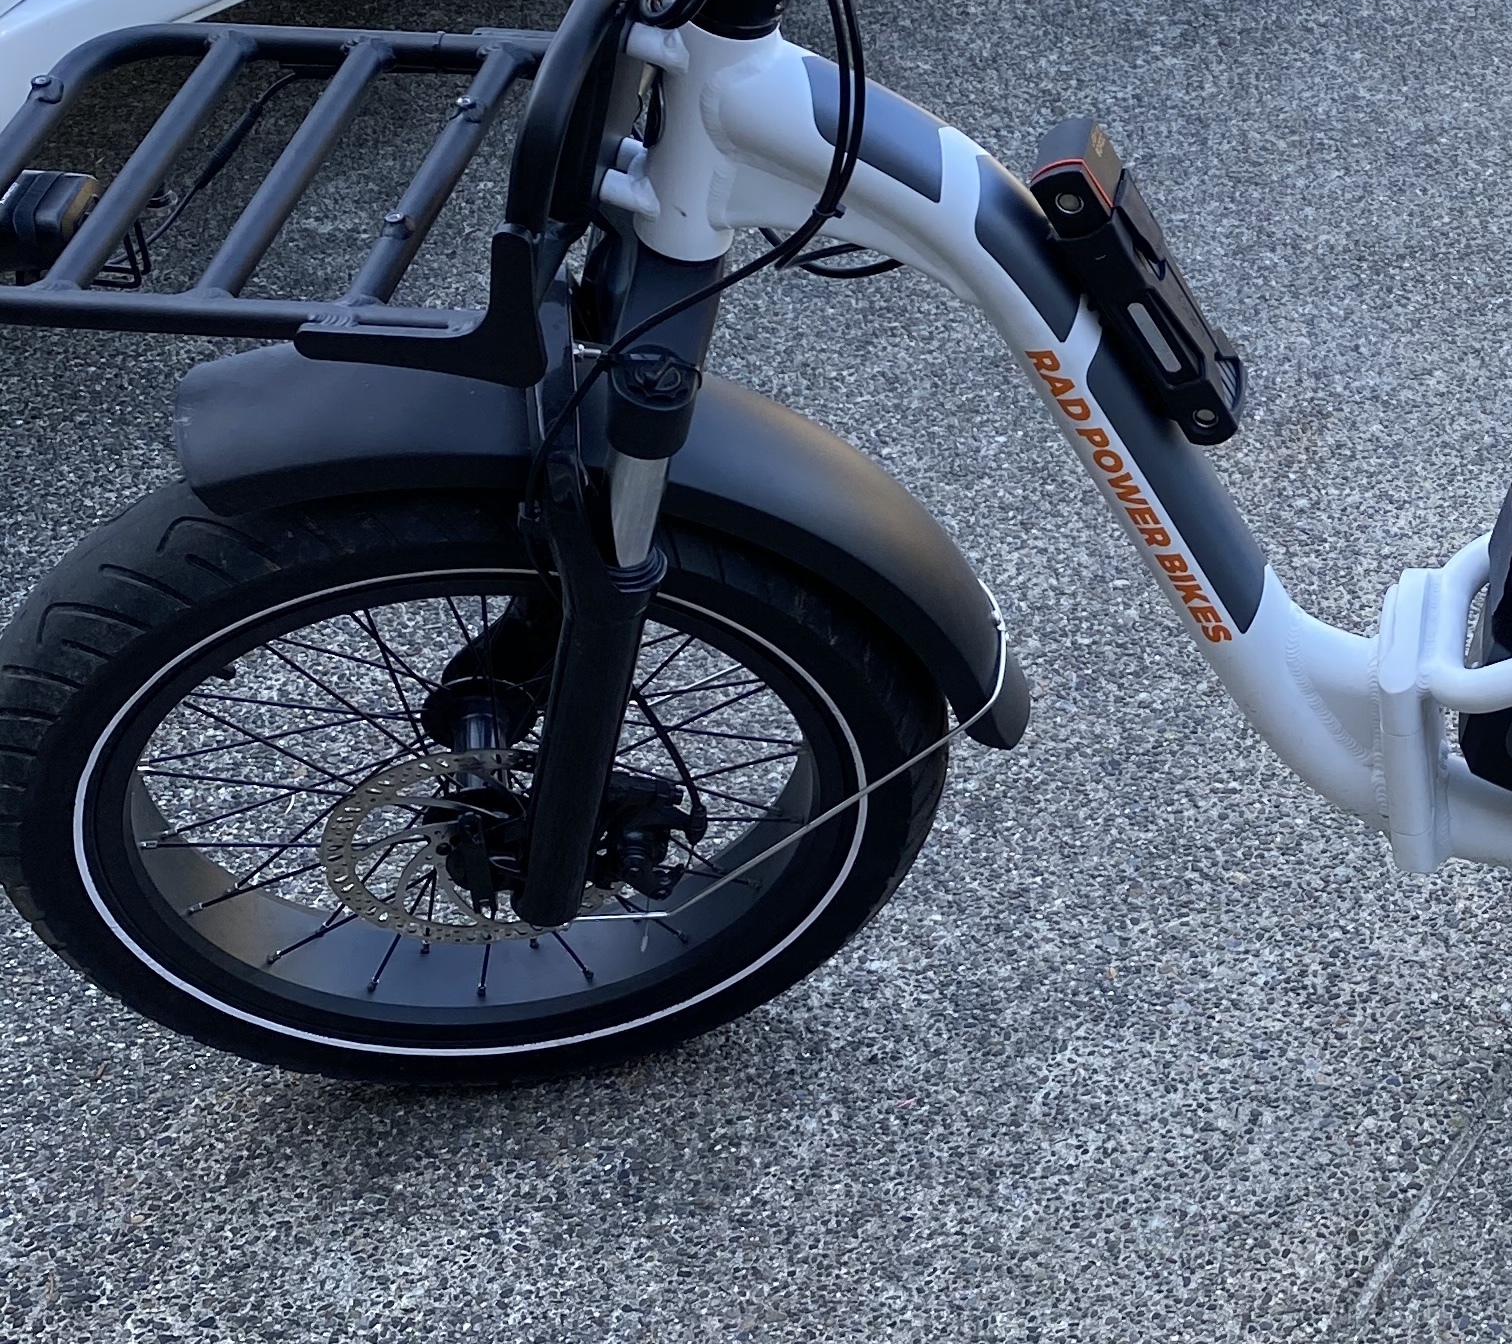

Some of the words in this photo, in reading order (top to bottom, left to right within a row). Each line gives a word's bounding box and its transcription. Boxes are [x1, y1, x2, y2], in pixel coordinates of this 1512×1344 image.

[1024, 349, 1092, 422] RAD
[1075, 427, 1172, 548] POWER
[1154, 552, 1233, 644] BIKES
